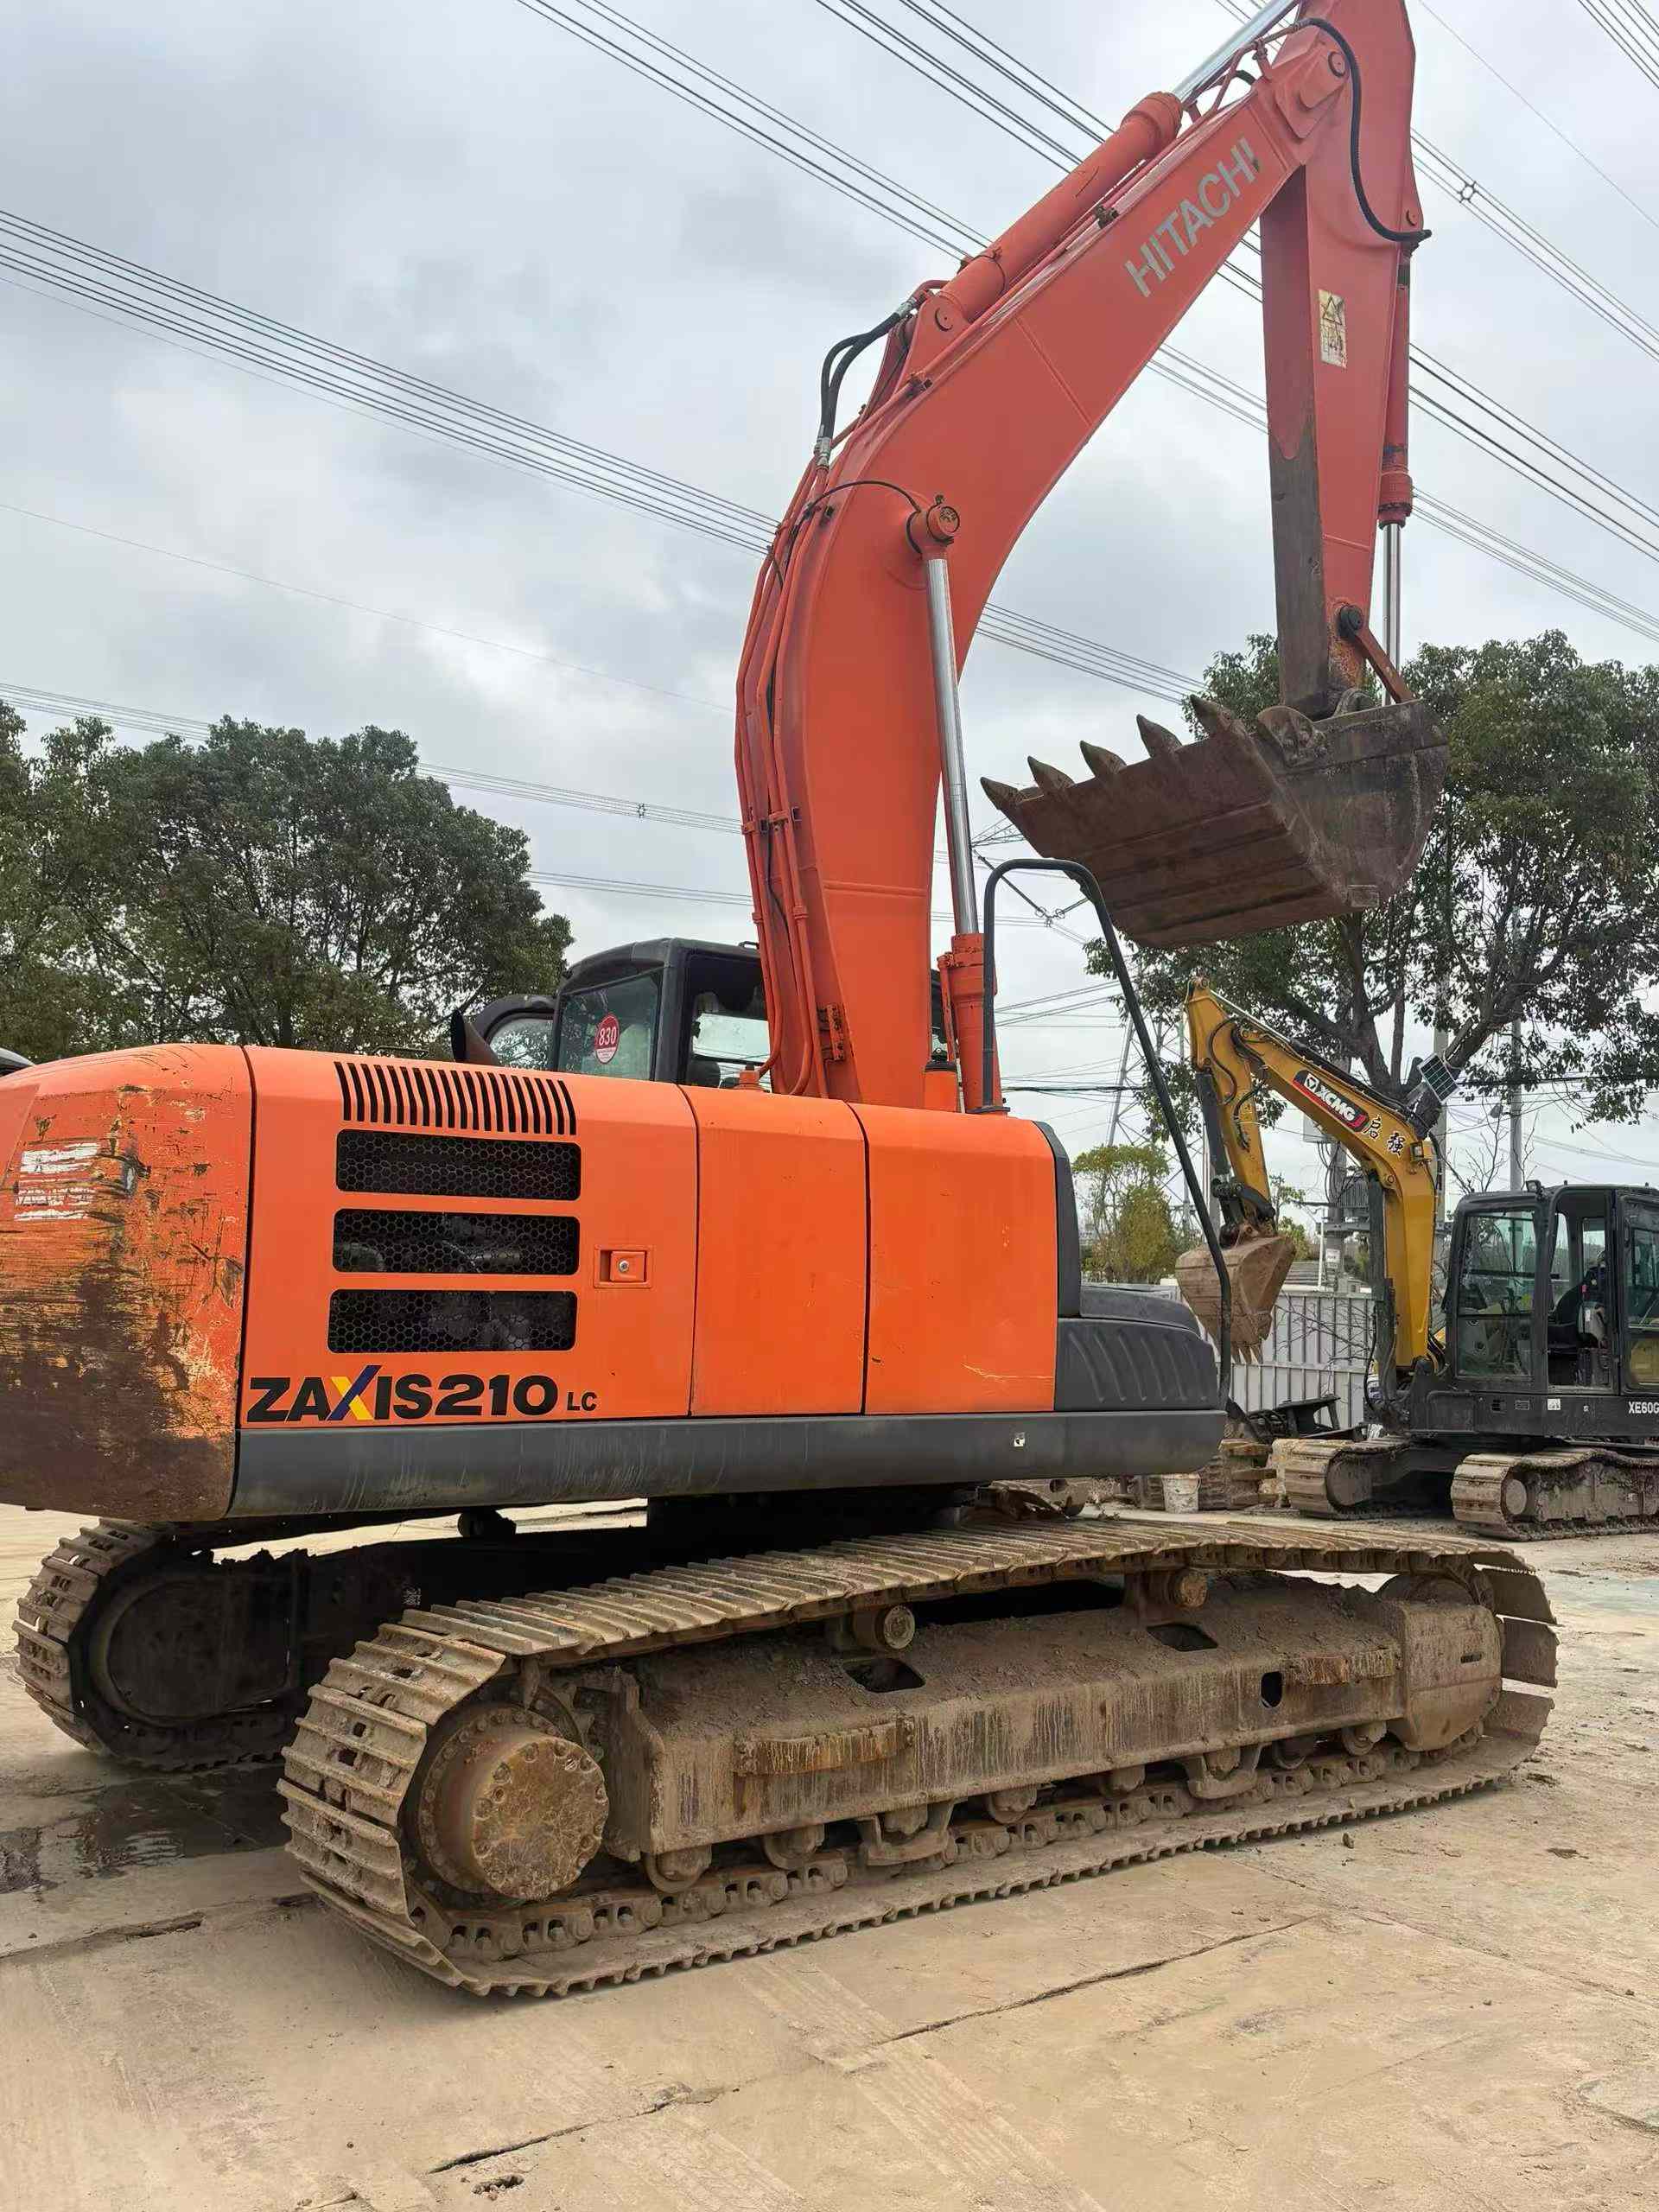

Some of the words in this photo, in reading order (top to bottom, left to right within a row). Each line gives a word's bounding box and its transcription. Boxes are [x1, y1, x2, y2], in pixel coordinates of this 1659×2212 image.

[1125, 136, 1260, 298] HITACHI
[599, 1026, 617, 1046] 830
[1317, 1084, 1356, 1122] XCMG
[567, 1390, 597, 1412] LC
[1628, 1401, 1659, 1414] XE60G
